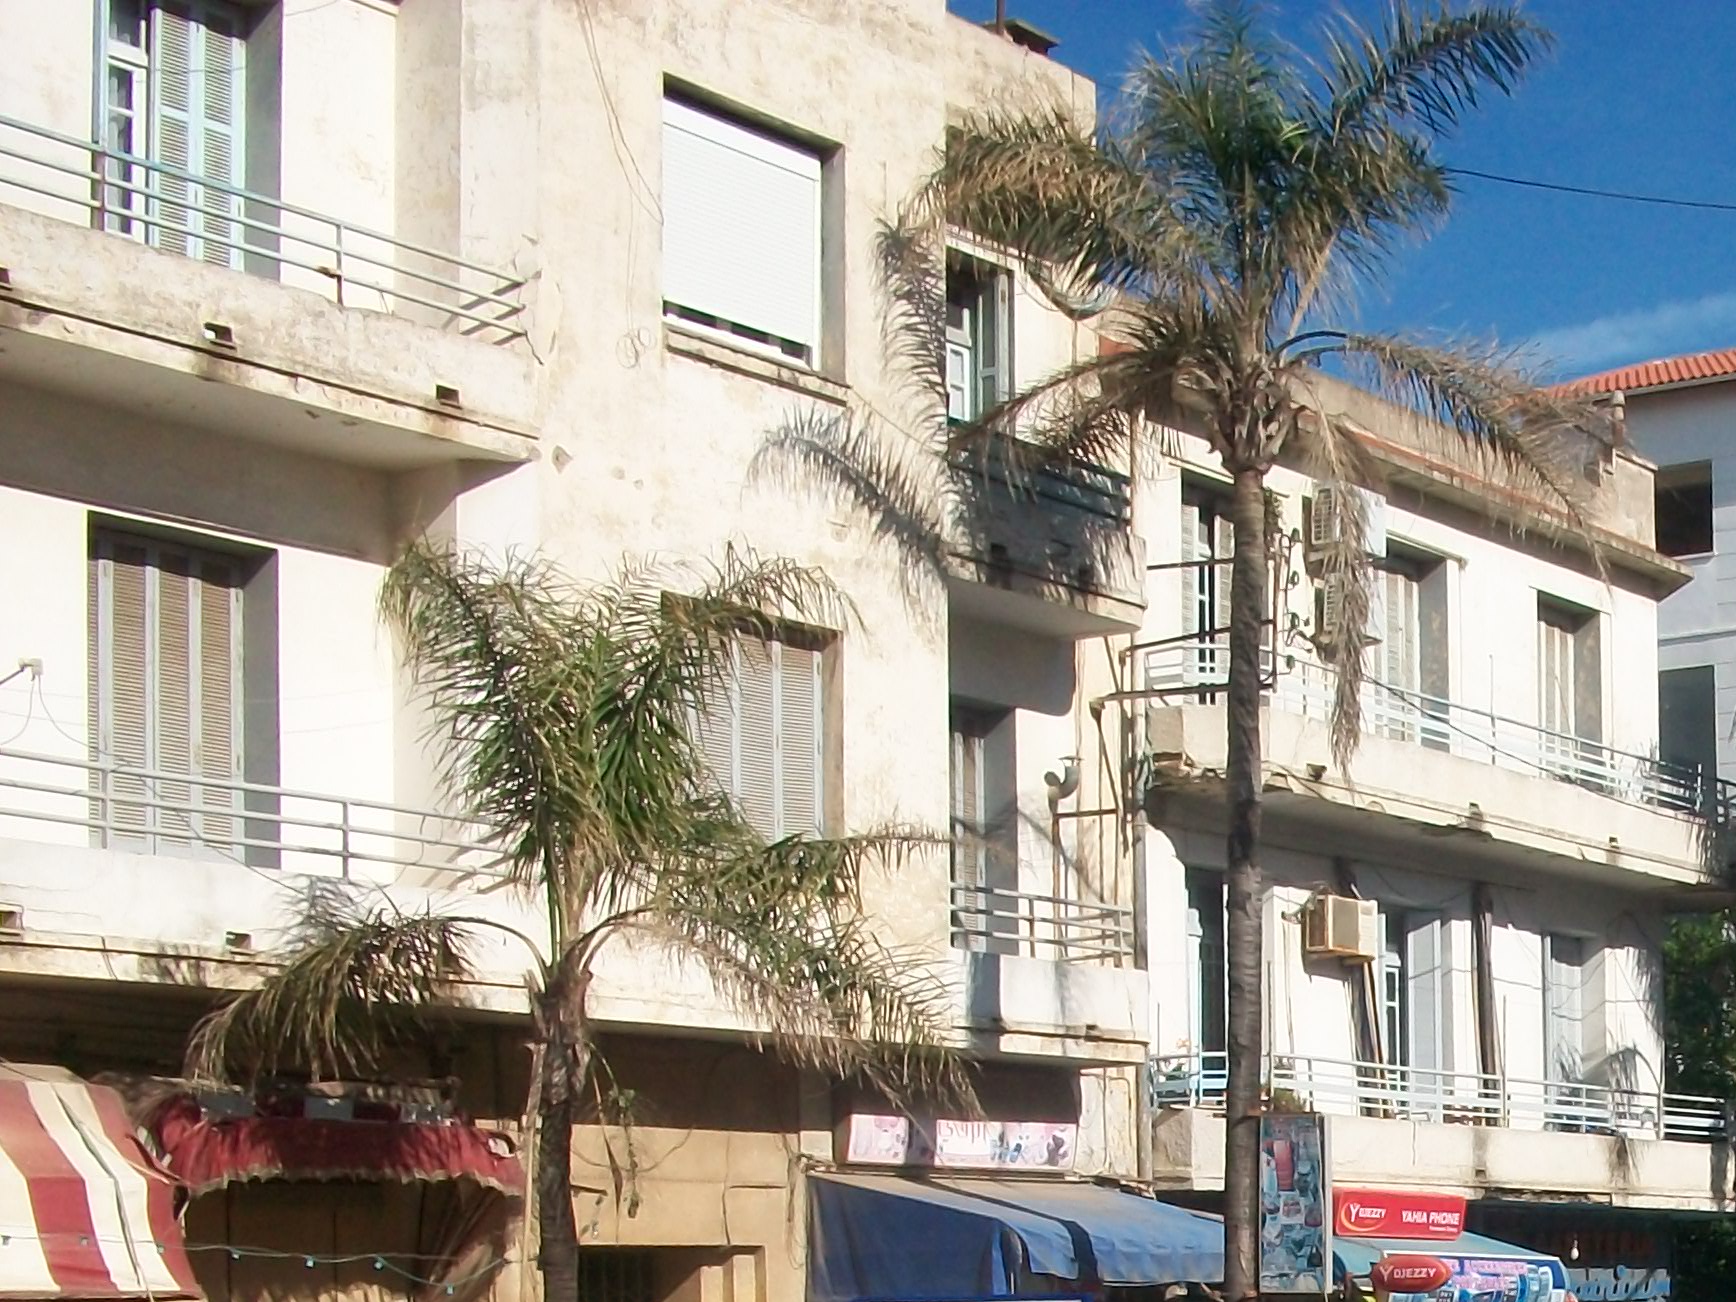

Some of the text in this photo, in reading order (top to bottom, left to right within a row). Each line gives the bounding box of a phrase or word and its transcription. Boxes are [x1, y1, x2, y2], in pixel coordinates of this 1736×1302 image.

[1401, 1210, 1428, 1224] YAHIA
[1428, 1211, 1461, 1226] PHONE
[1393, 1267, 1437, 1279] DJEZZY
